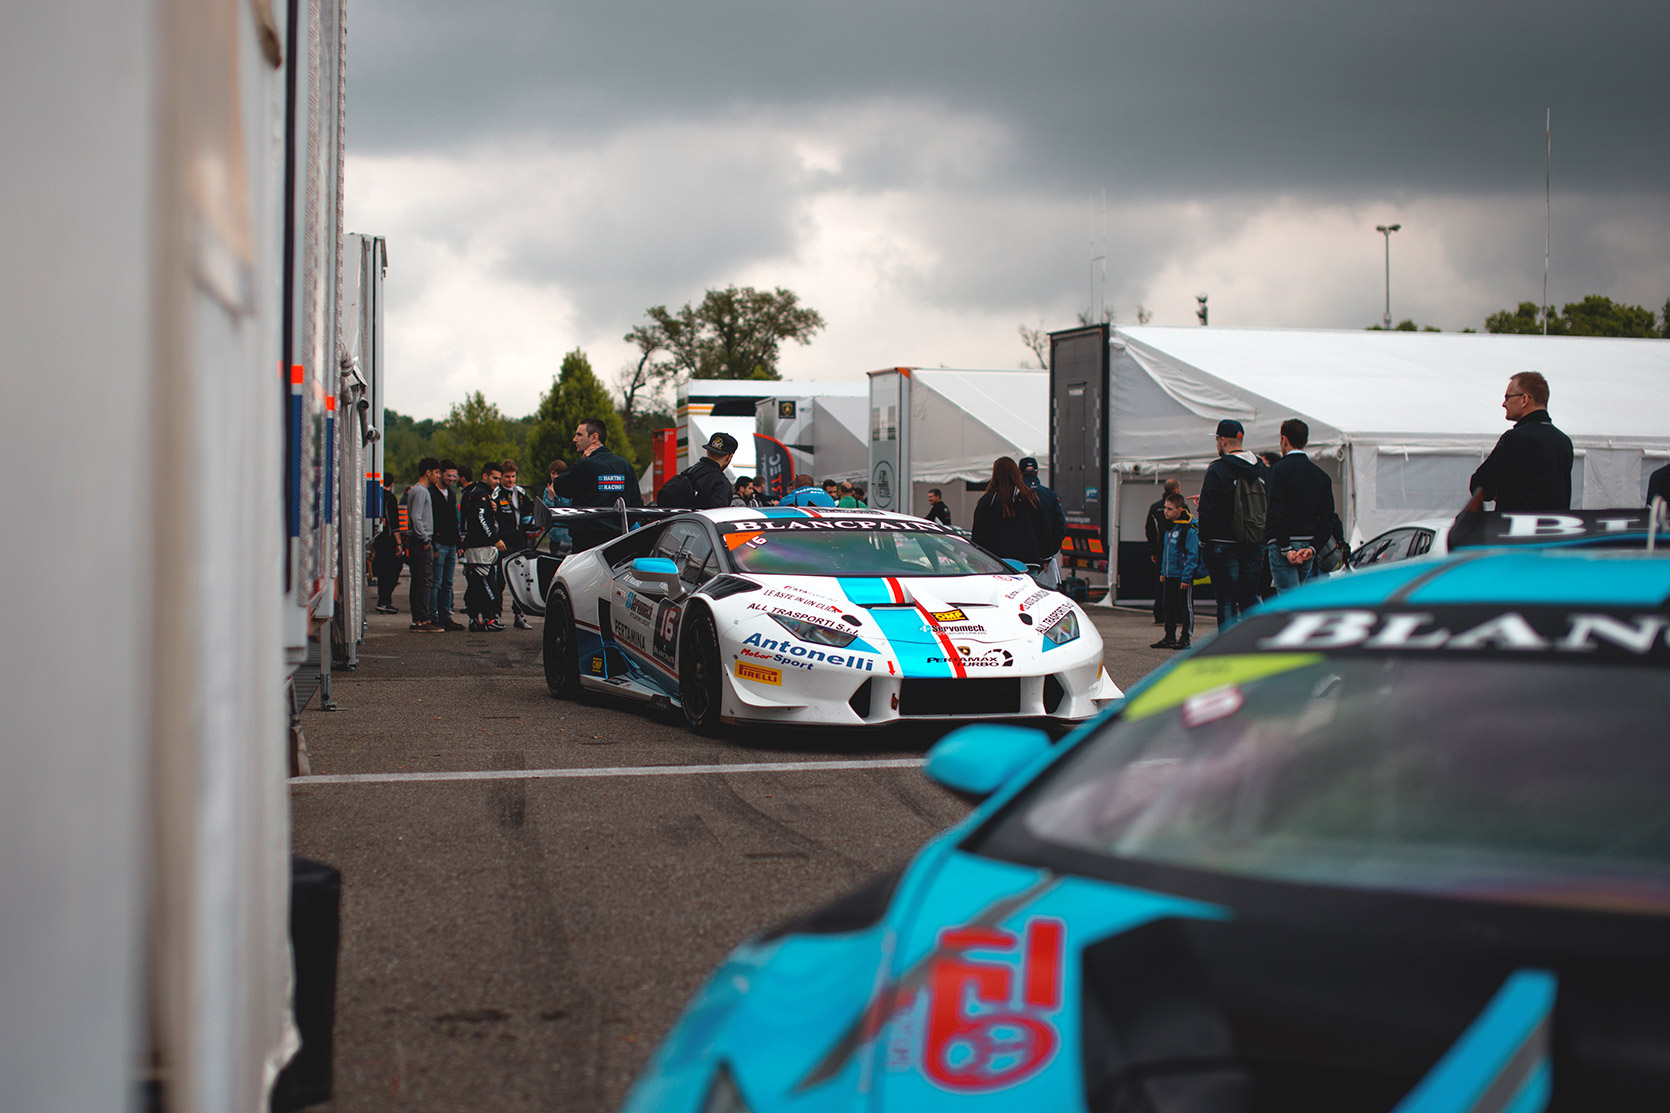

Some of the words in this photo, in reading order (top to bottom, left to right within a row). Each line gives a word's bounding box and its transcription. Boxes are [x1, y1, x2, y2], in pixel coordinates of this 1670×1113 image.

[732, 520, 944, 532] BLANCPAIN
[746, 536, 768, 550] 16
[774, 591, 793, 600] ASTE
[804, 598, 816, 606] UN
[660, 608, 677, 642] 16
[746, 602, 768, 612] ALL
[772, 606, 835, 628] TRASPORTI
[934, 610, 963, 620] OMP
[614, 620, 646, 652] PERTAMINA
[1257, 608, 1670, 655] BLAN
[740, 648, 772, 660] Motor
[772, 654, 814, 670] Sport
[742, 632, 874, 671] Antonelli
[738, 663, 778, 682] PIRELLI
